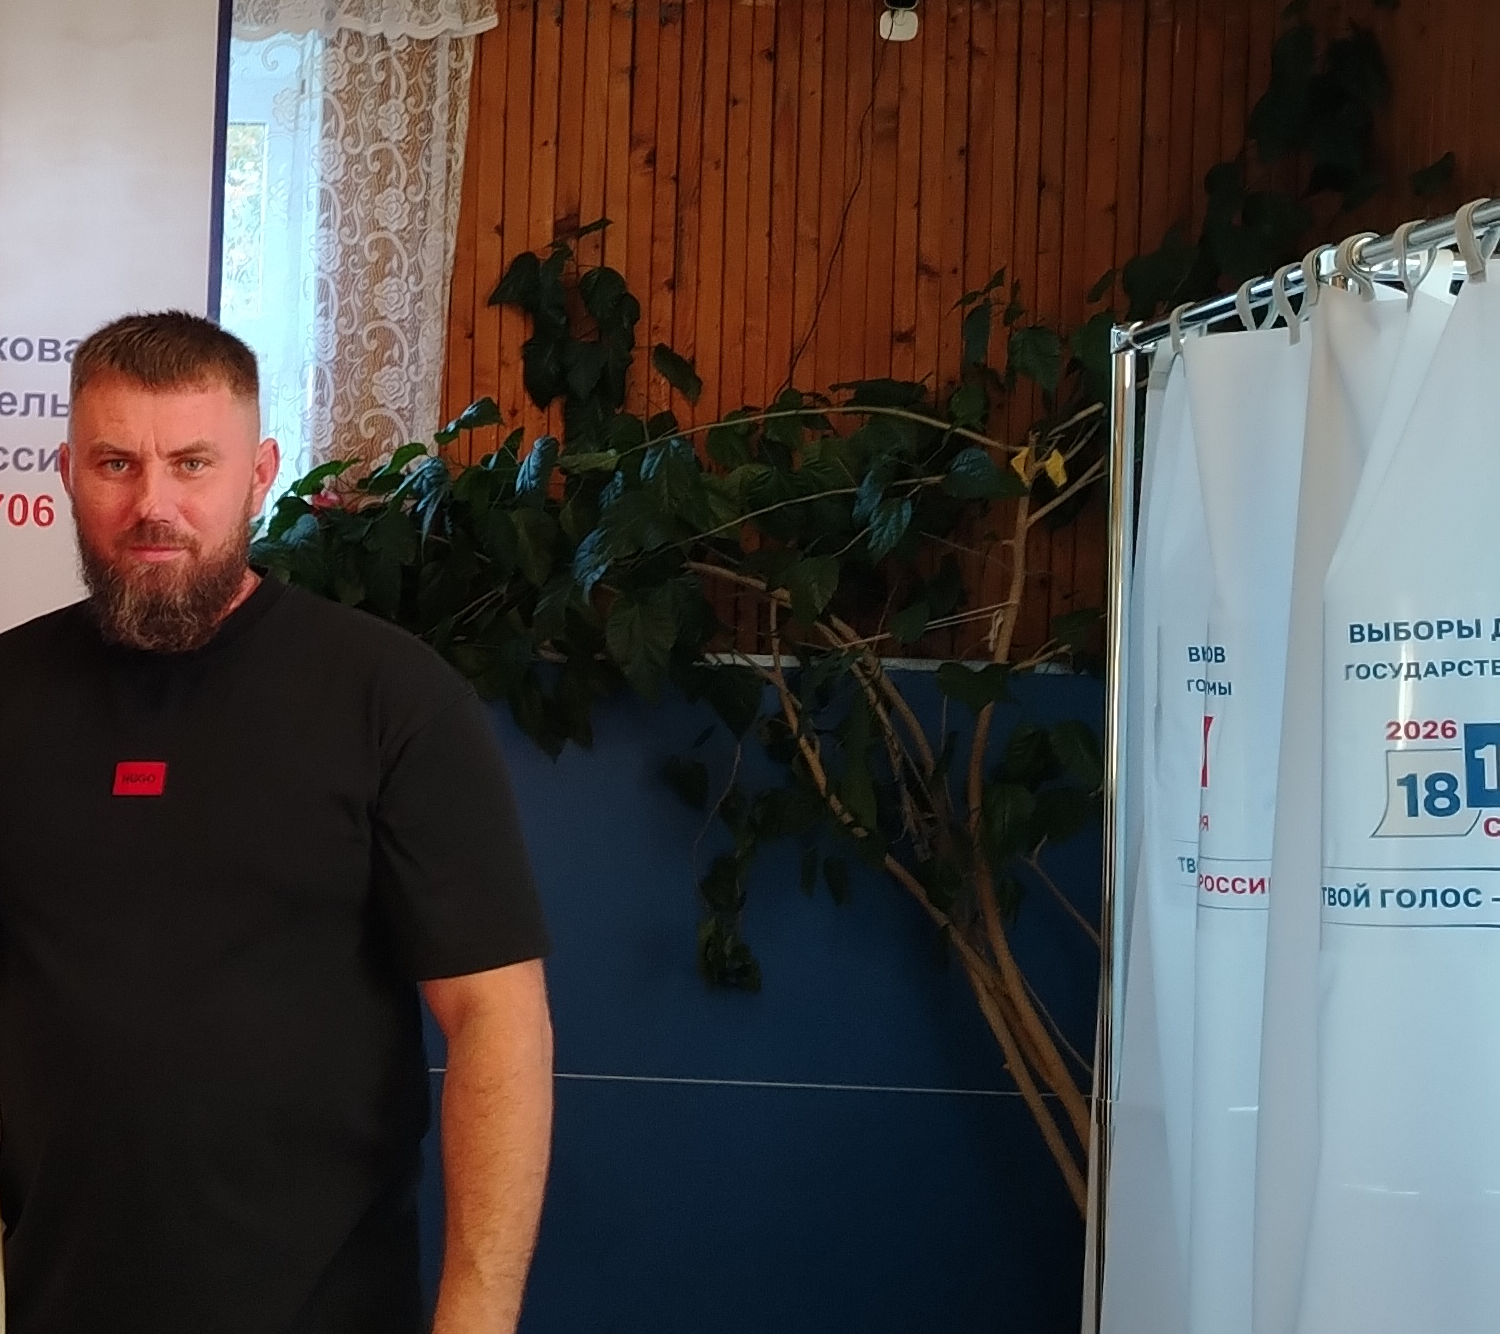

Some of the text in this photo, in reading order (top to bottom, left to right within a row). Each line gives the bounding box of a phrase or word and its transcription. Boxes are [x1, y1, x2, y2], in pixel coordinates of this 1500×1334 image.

[1349, 618, 1482, 644] ВЫБОРЫ
[1385, 719, 1457, 741] 2026
[1396, 771, 1461, 818] 18
[1321, 882, 1483, 909] ТВОЙ ГОЛОС
